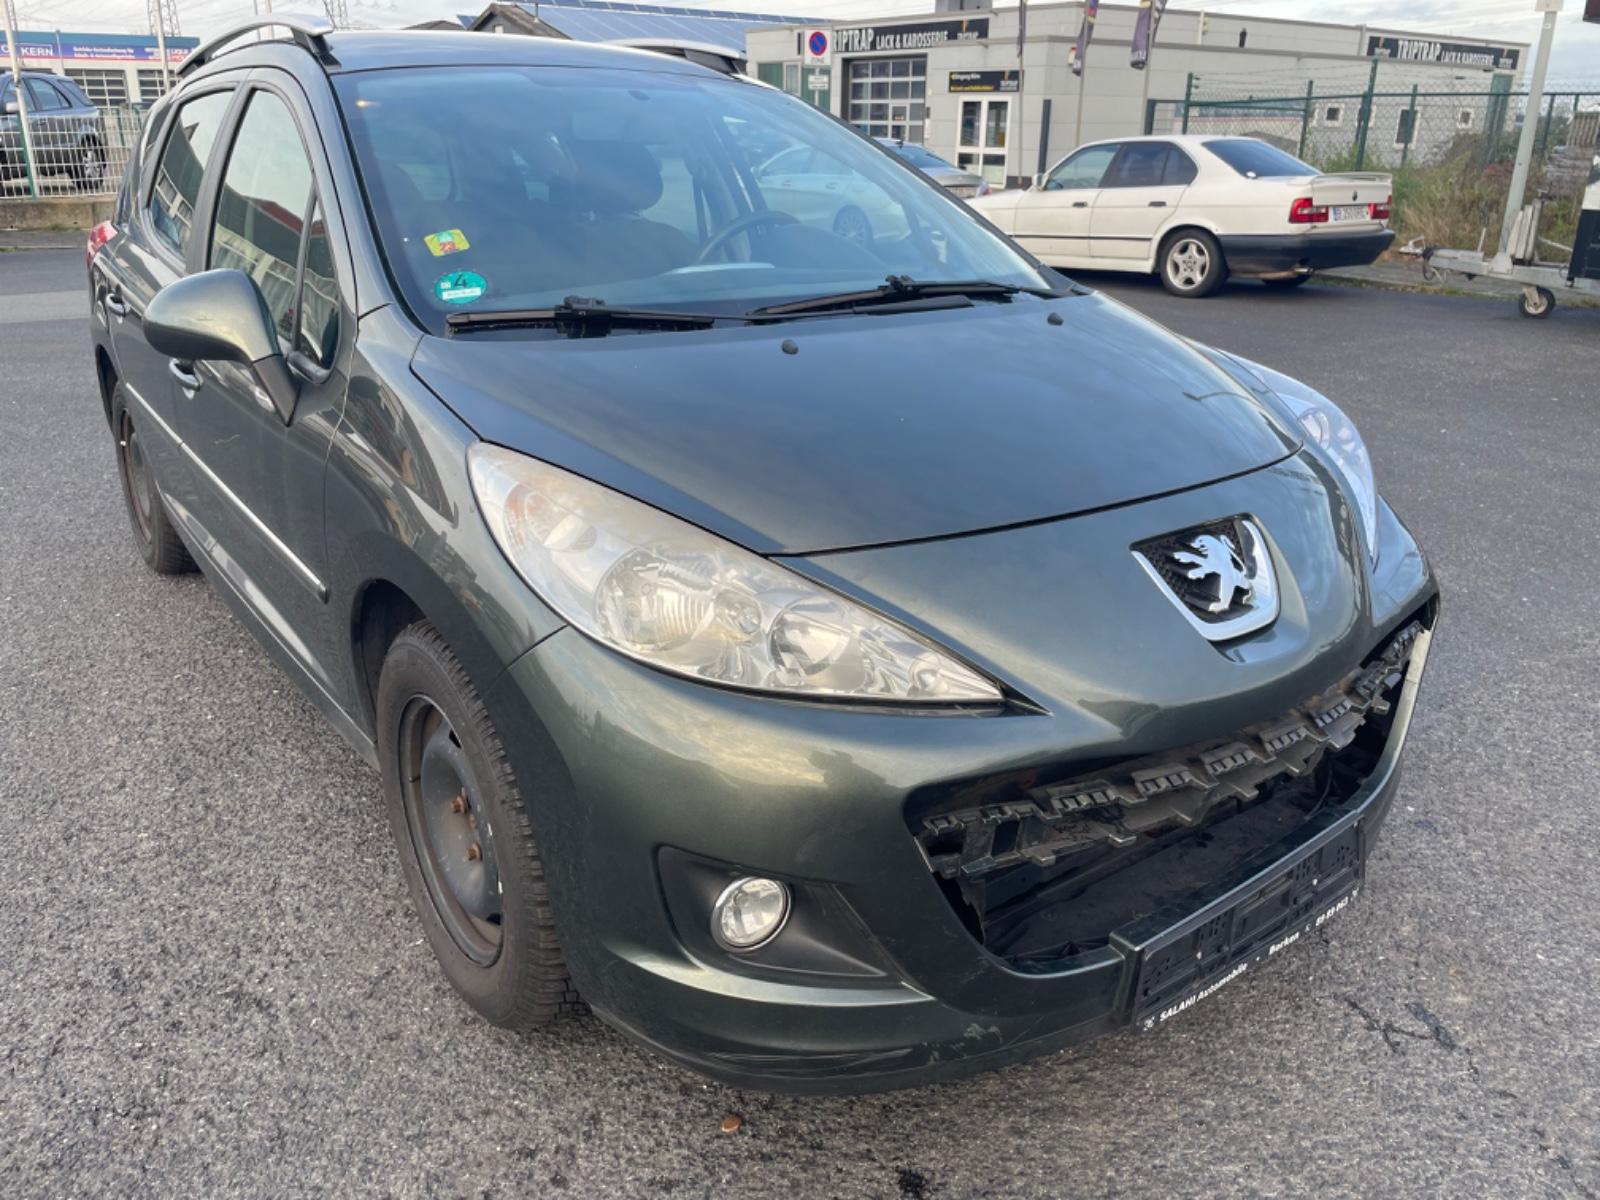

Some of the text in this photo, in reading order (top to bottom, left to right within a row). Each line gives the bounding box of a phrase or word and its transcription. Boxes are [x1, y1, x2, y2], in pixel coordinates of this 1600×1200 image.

[21, 46, 53, 56] KERN
[832, 28, 874, 52] RIPTRAP
[876, 33, 895, 50] LACK
[902, 30, 949, 49] KAROSSERIE
[1397, 39, 1442, 62] TRIPTRAP
[454, 273, 467, 288] 4
[1159, 994, 1198, 1022] SALANI
